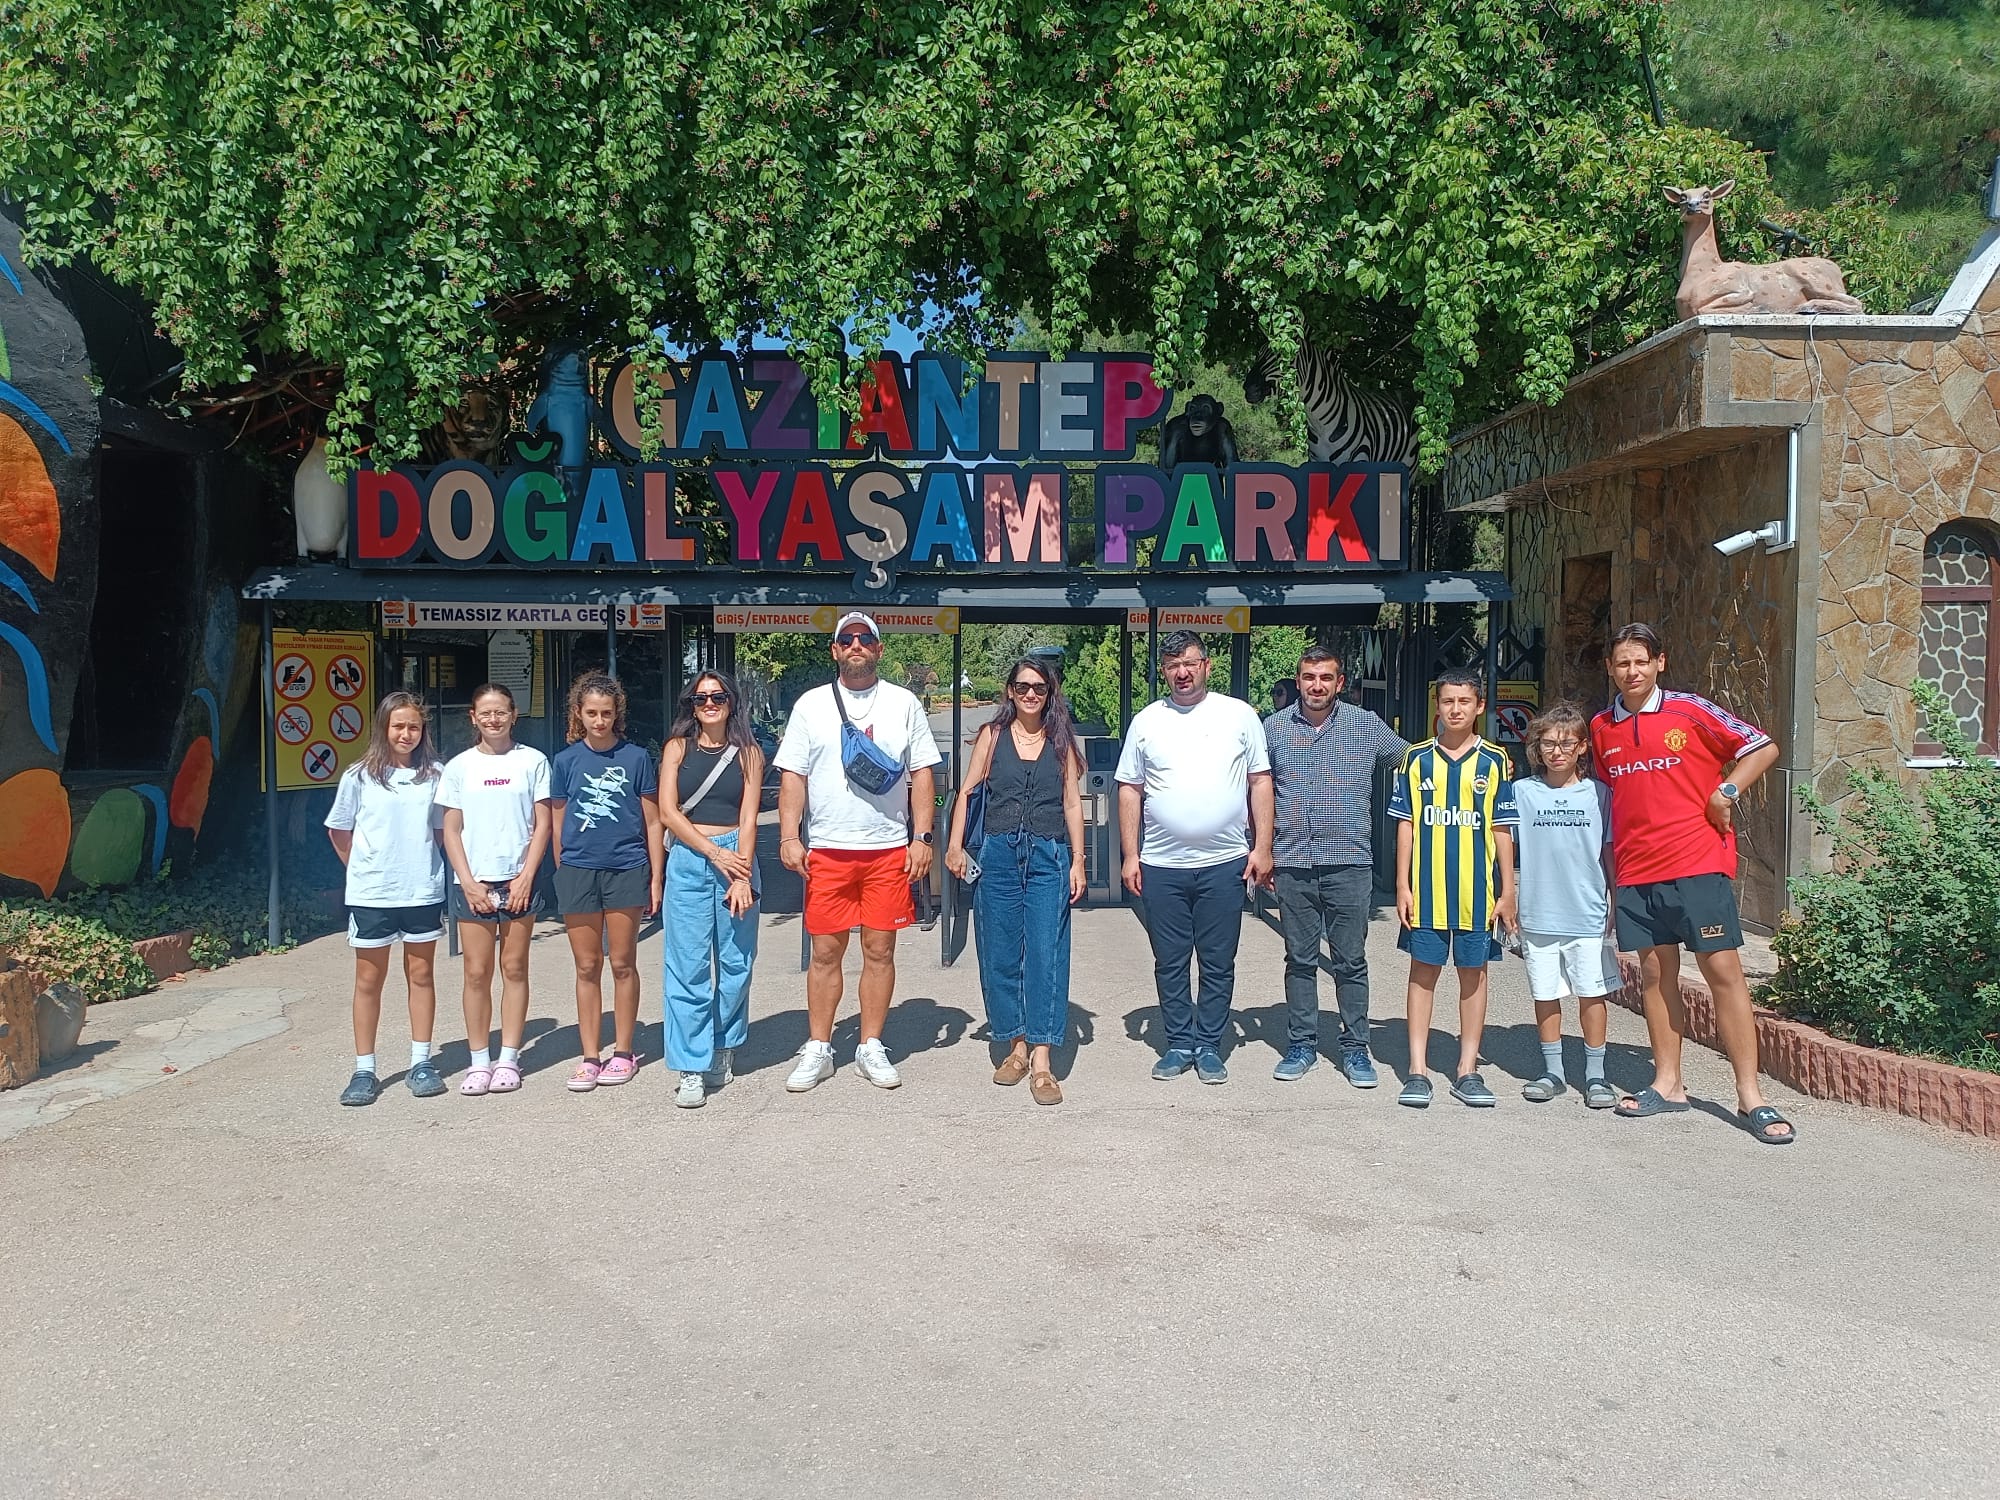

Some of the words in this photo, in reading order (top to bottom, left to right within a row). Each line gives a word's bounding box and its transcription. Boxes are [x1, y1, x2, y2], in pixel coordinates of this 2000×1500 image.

[356, 440, 695, 562] DOĞAL
[714, 470, 1062, 590] YAŞAM
[1103, 472, 1402, 564] PARKI
[420, 607, 502, 621] TEMASSIZ
[507, 608, 572, 622] KARTLA
[577, 608, 626, 626] GEÇŞ
[1235, 610, 1245, 629] 1
[1609, 756, 1681, 778] SHARP
[484, 777, 511, 787] miav
[1537, 809, 1585, 819] UNDER
[1532, 818, 1592, 828] ARMOUR
[1700, 924, 1724, 936] EA7
